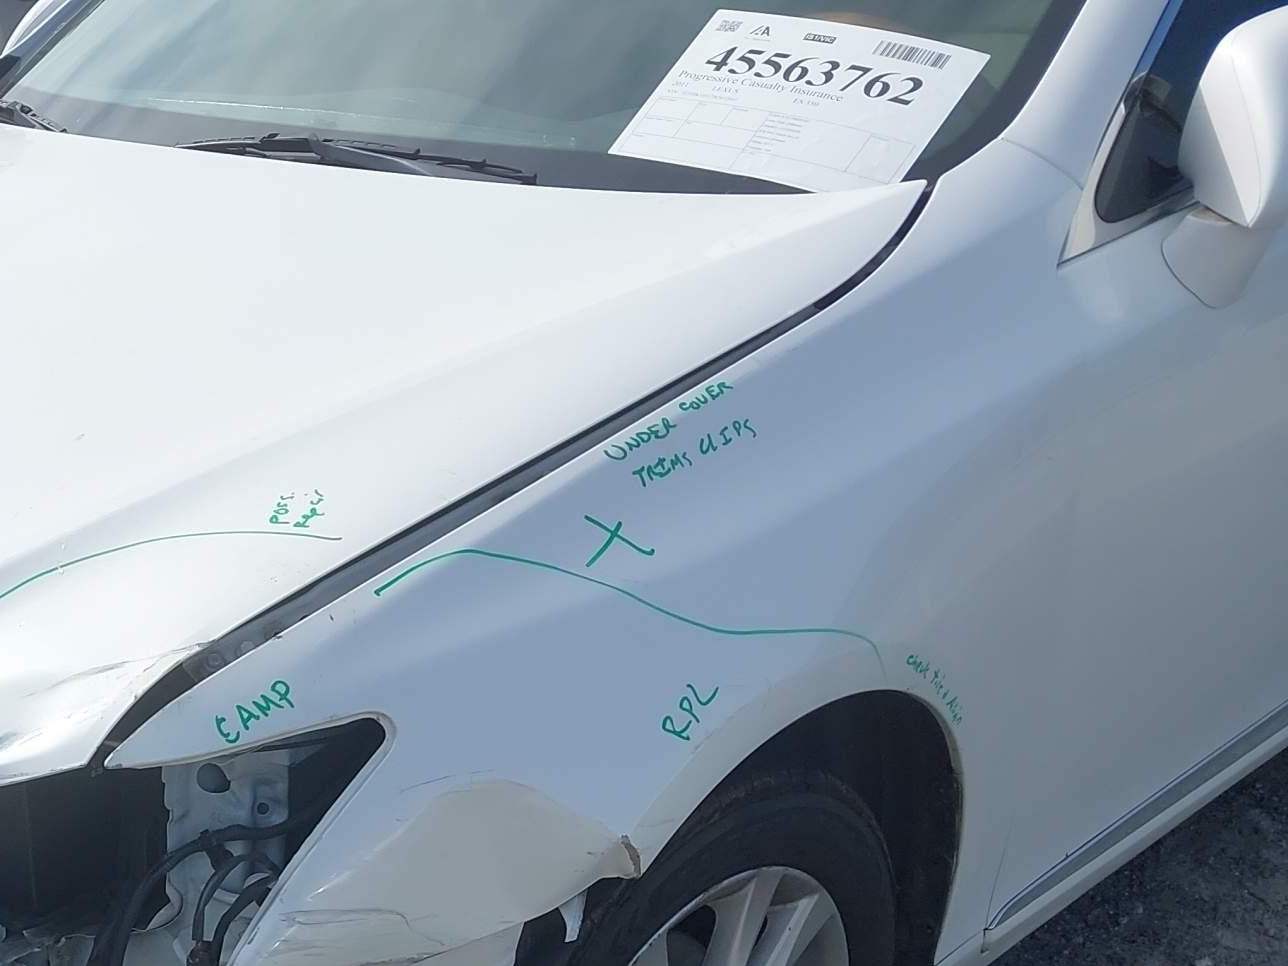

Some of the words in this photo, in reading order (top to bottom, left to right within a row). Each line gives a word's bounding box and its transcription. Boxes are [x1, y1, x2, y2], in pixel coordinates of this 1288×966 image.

[678, 70, 739, 84] Progressive
[740, 78, 785, 93] Casualty
[789, 86, 844, 102] Insurance
[705, 46, 923, 106] 45563762
[603, 417, 677, 461] UNDER
[678, 381, 734, 412] COVER
